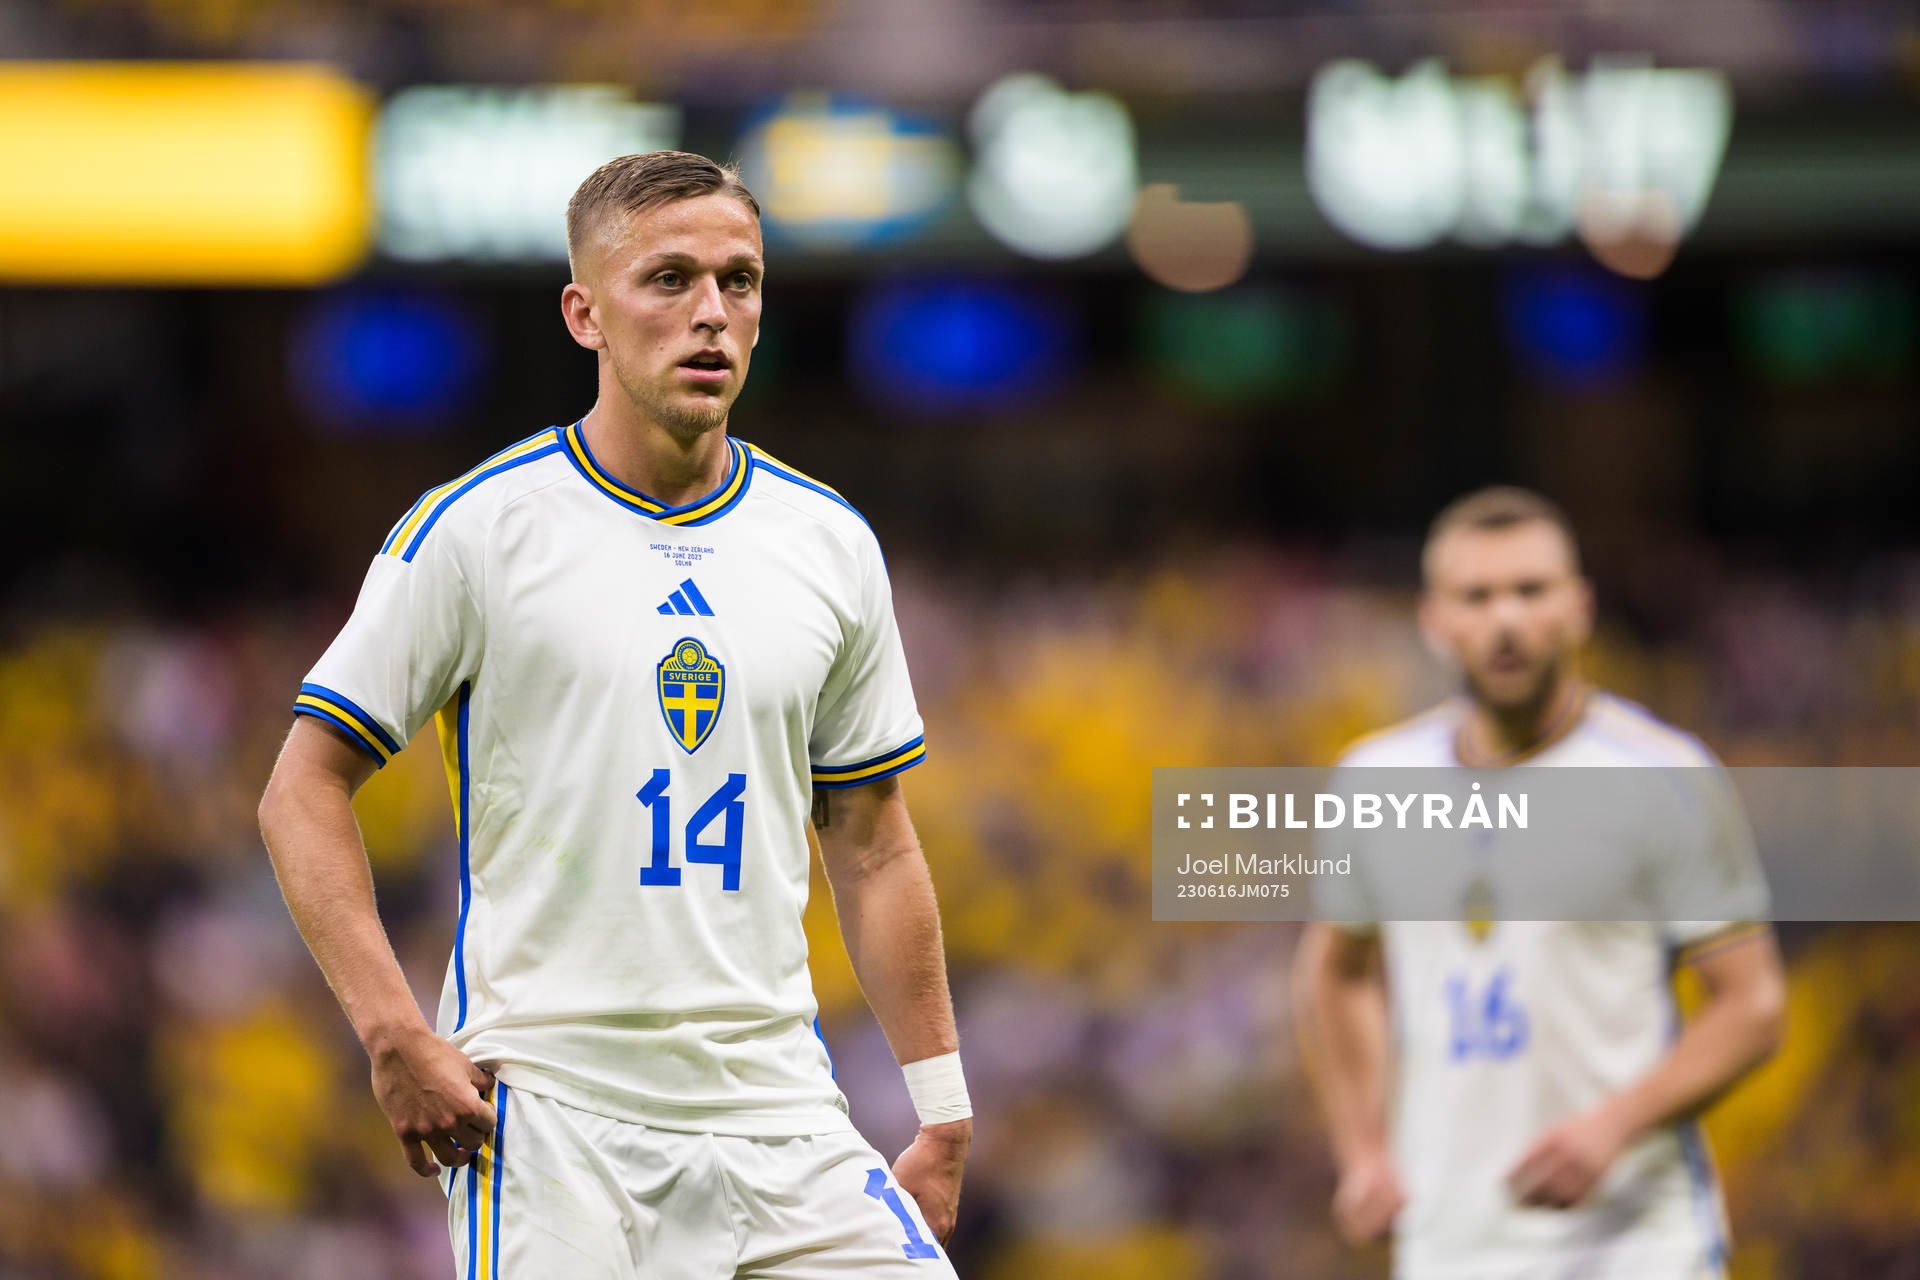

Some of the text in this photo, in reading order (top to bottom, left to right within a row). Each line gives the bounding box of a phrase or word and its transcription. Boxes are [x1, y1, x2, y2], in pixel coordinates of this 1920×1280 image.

[669, 672, 712, 681] SVERIGE
[636, 768, 747, 891] 14
[863, 1168, 940, 1259] 1
